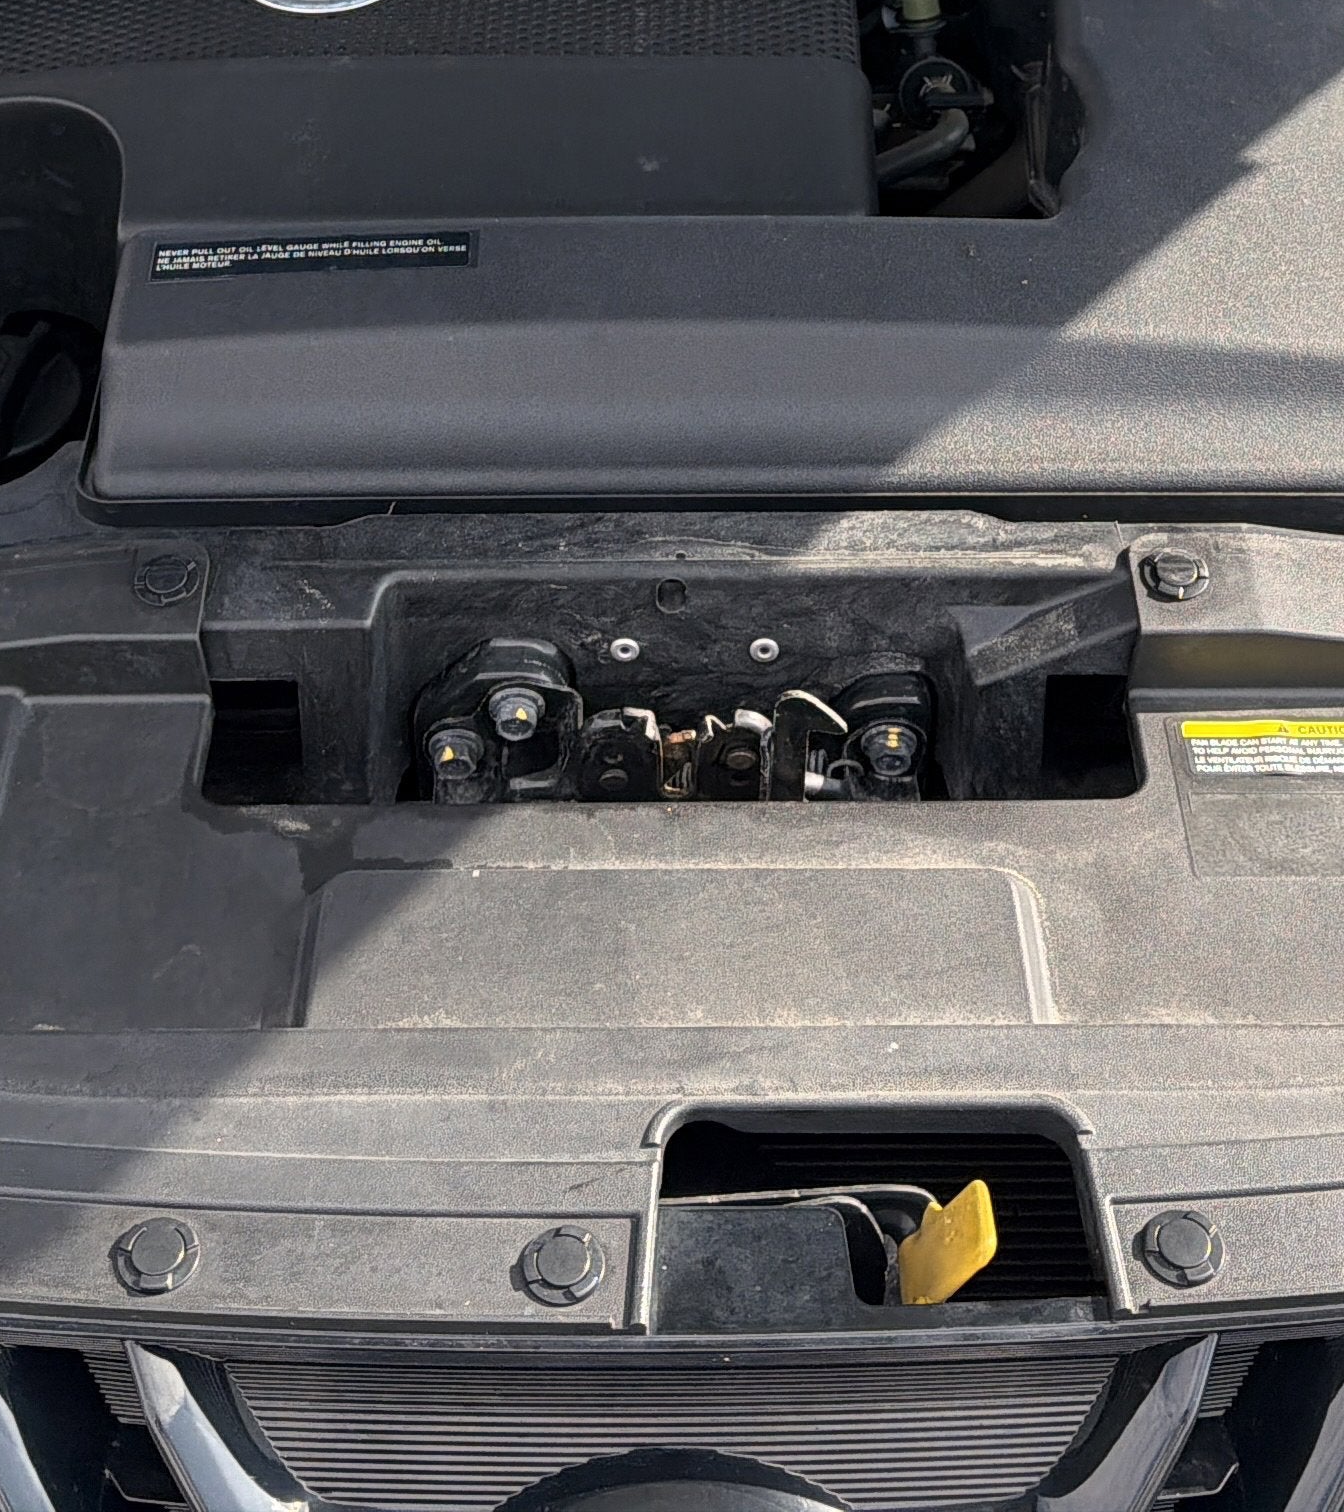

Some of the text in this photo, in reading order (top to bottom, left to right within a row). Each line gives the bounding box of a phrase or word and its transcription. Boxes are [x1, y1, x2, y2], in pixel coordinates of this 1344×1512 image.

[158, 248, 190, 257] NEVER
[217, 246, 236, 254] OUT
[238, 246, 254, 254] OIL
[286, 243, 319, 251] GAUGE
[322, 241, 350, 249] WHILE
[352, 240, 387, 248] FILLING
[389, 239, 424, 247] ENGINE
[426, 238, 444, 246] OIL.
[172, 255, 206, 264] JAMAIS
[247, 252, 259, 260] LA
[260, 251, 290, 260] JAUGE
[292, 250, 306, 258] DE
[307, 249, 342, 258] NIVEAU
[344, 248, 380, 256] D'HUILE
[437, 244, 467, 253] VERSE
[156, 262, 190, 272] L'HUILE
[1240, 738, 1260, 746] CAN
[1301, 738, 1319, 746] ANY
[1192, 746, 1205, 754] TO
[1206, 746, 1230, 755] HELP
[1230, 746, 1258, 755] AVOID
